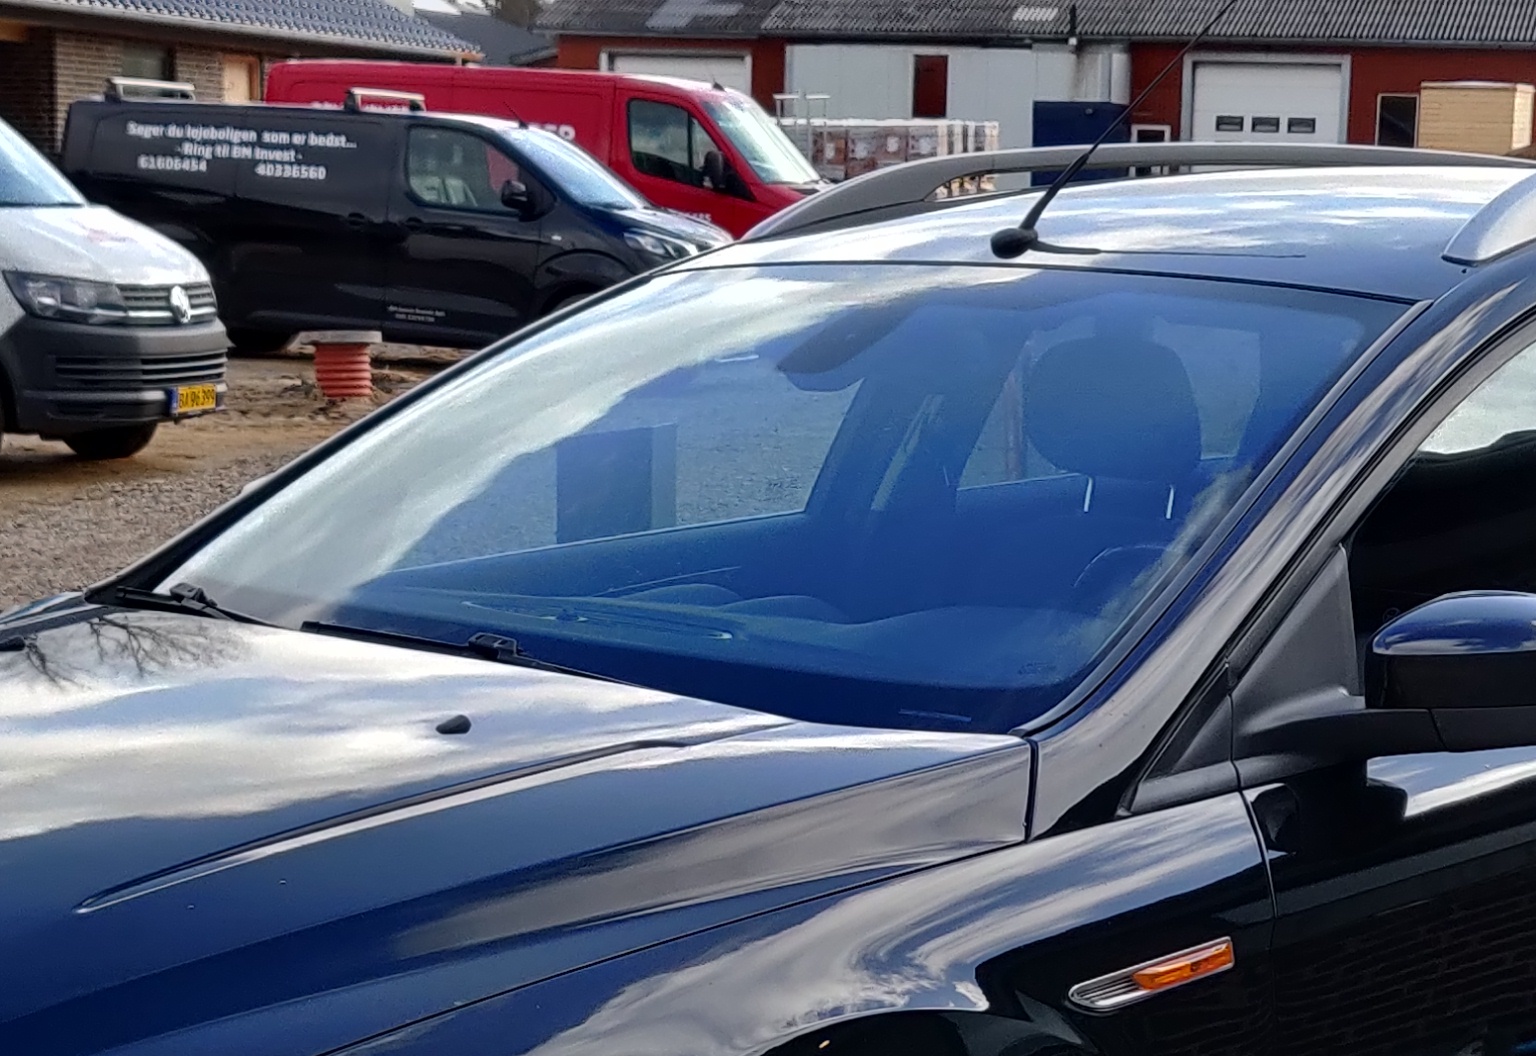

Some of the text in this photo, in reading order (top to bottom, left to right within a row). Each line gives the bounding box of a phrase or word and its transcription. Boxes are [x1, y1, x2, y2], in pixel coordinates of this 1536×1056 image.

[167, 124, 183, 138] du
[261, 130, 290, 145] som
[215, 142, 229, 158] til
